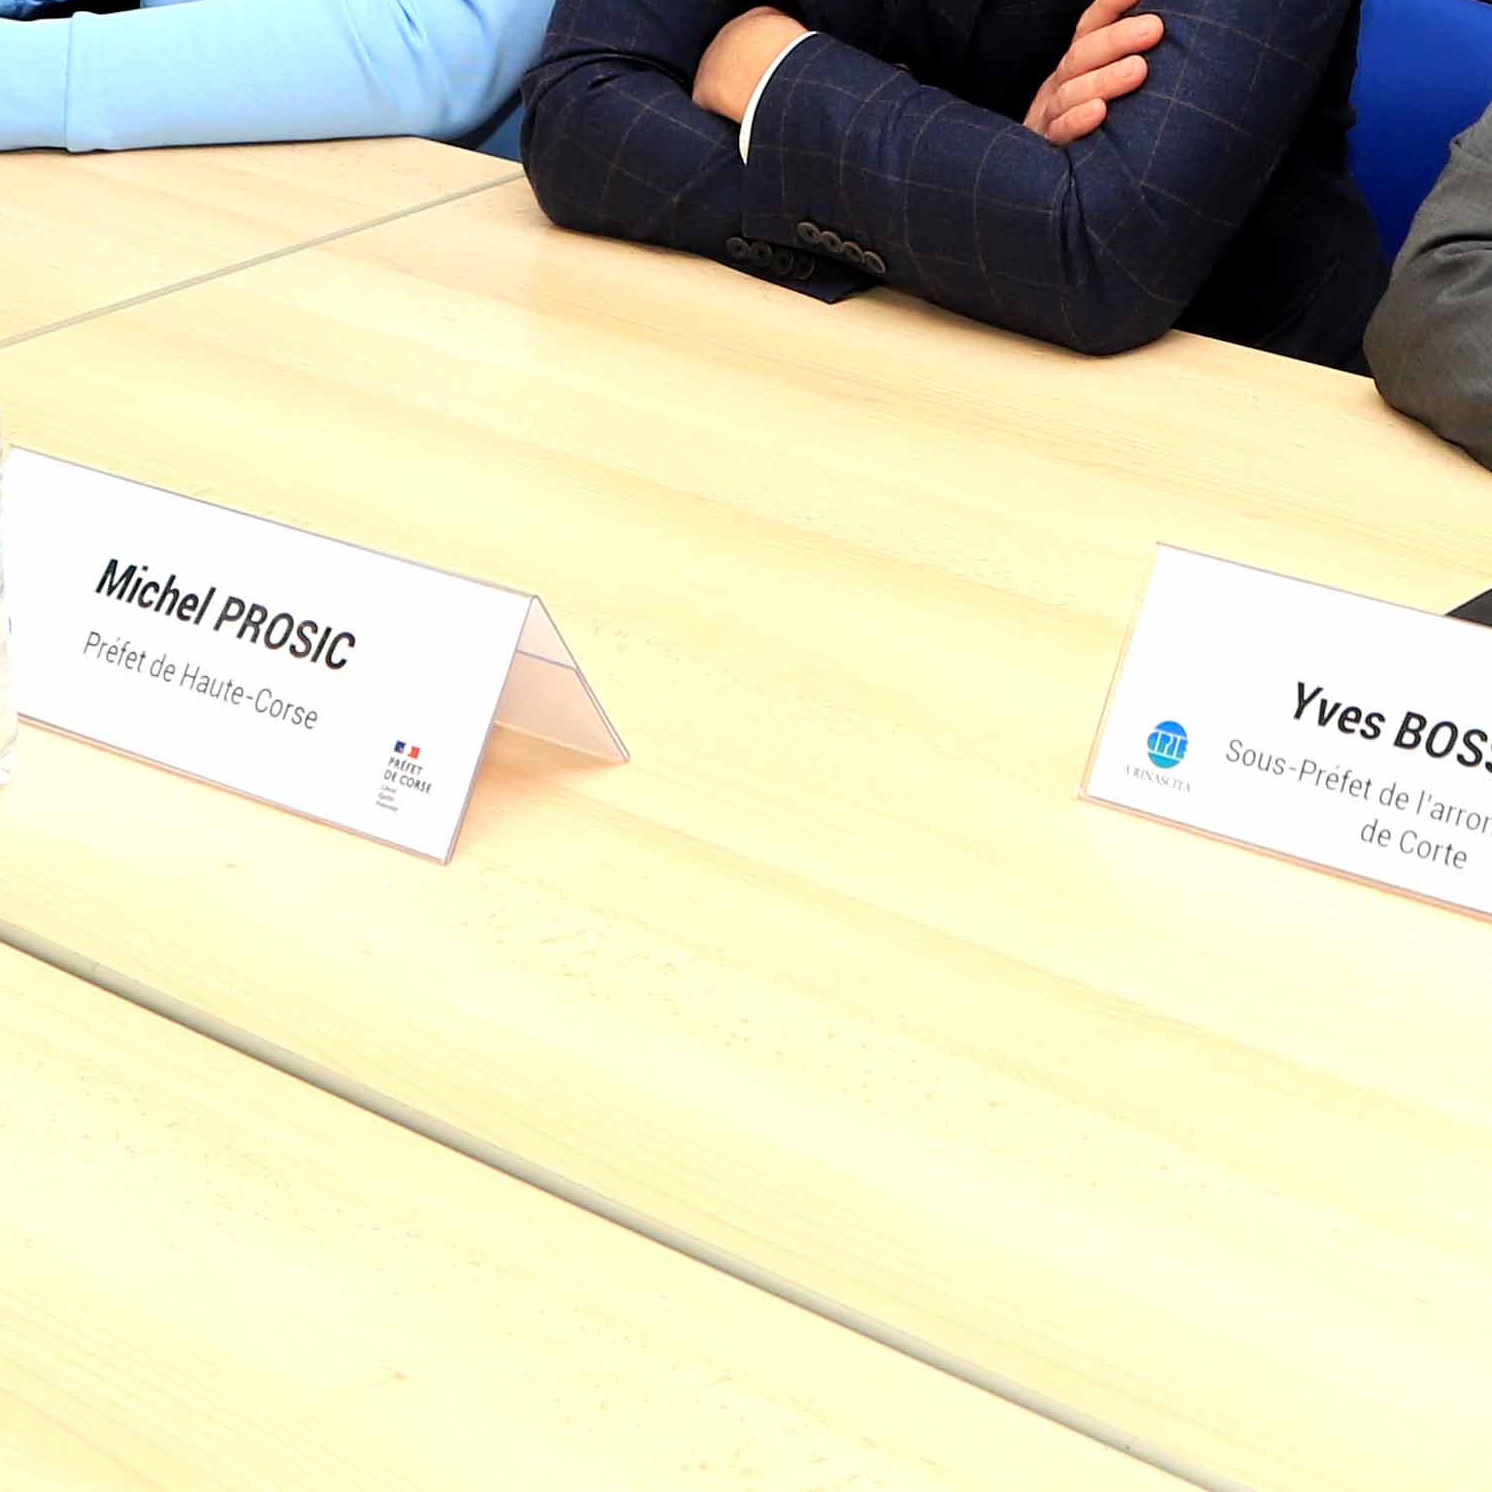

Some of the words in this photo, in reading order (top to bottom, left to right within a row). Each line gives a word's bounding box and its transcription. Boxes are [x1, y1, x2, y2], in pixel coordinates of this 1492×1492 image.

[95, 557, 217, 626] Michel
[212, 594, 357, 671] PROSIC
[83, 630, 147, 674] Préfet
[149, 652, 177, 683] de
[179, 661, 319, 731] Haute-Corse
[1291, 680, 1384, 743] Yves
[383, 768, 398, 783] DE
[398, 774, 433, 795] CORSE
[388, 756, 424, 777] PRÉFET
[1224, 738, 1373, 803] Sous-Préfet
[1377, 778, 1410, 811] de
[1359, 816, 1393, 848] de
[1398, 826, 1469, 872] Corte
